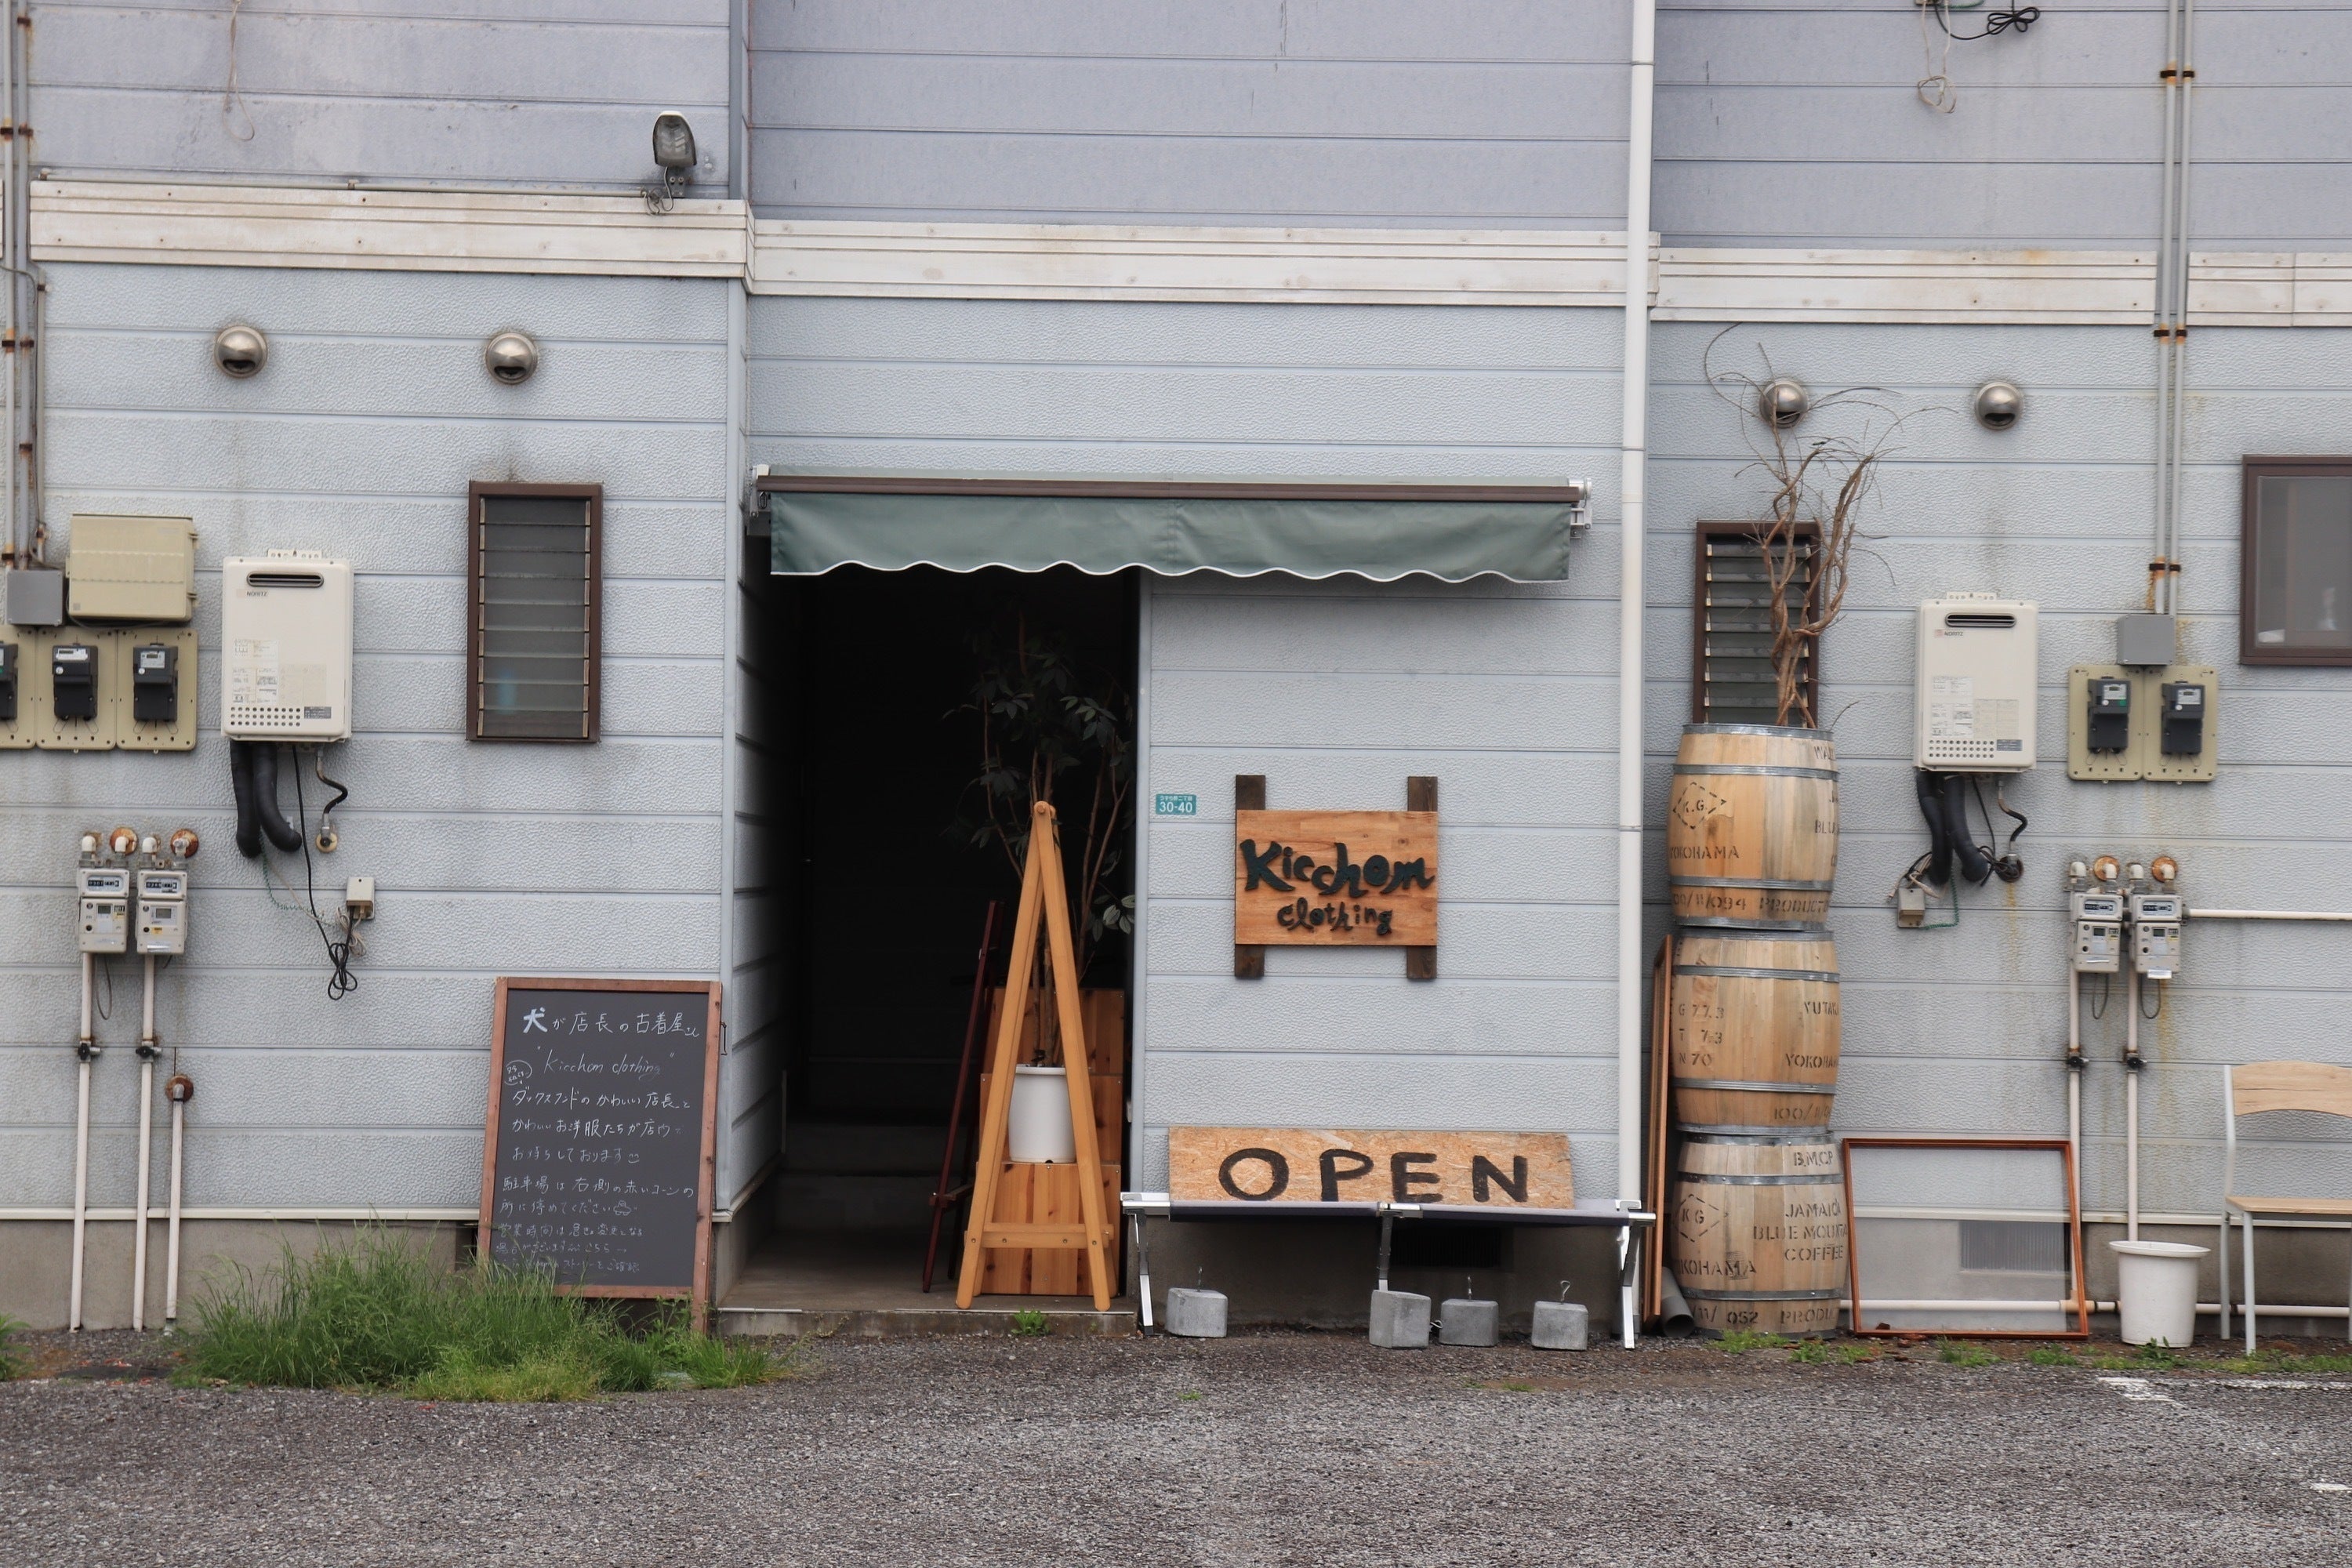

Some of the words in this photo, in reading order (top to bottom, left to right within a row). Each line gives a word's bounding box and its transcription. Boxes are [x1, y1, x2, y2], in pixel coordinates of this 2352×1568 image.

[1160, 801, 1192, 812] 30-40
[1240, 839, 1436, 898] Kicchom
[1277, 898, 1392, 935] clothing
[1679, 1004, 1685, 1016] G
[523, 1007, 699, 1038] 犬が店長の古着屋さん
[1691, 1054, 1712, 1066] 70
[1219, 1148, 1528, 1203] OPEN
[1753, 1225, 1798, 1240] BLUE
[1784, 1245, 1843, 1261] COFFEE
